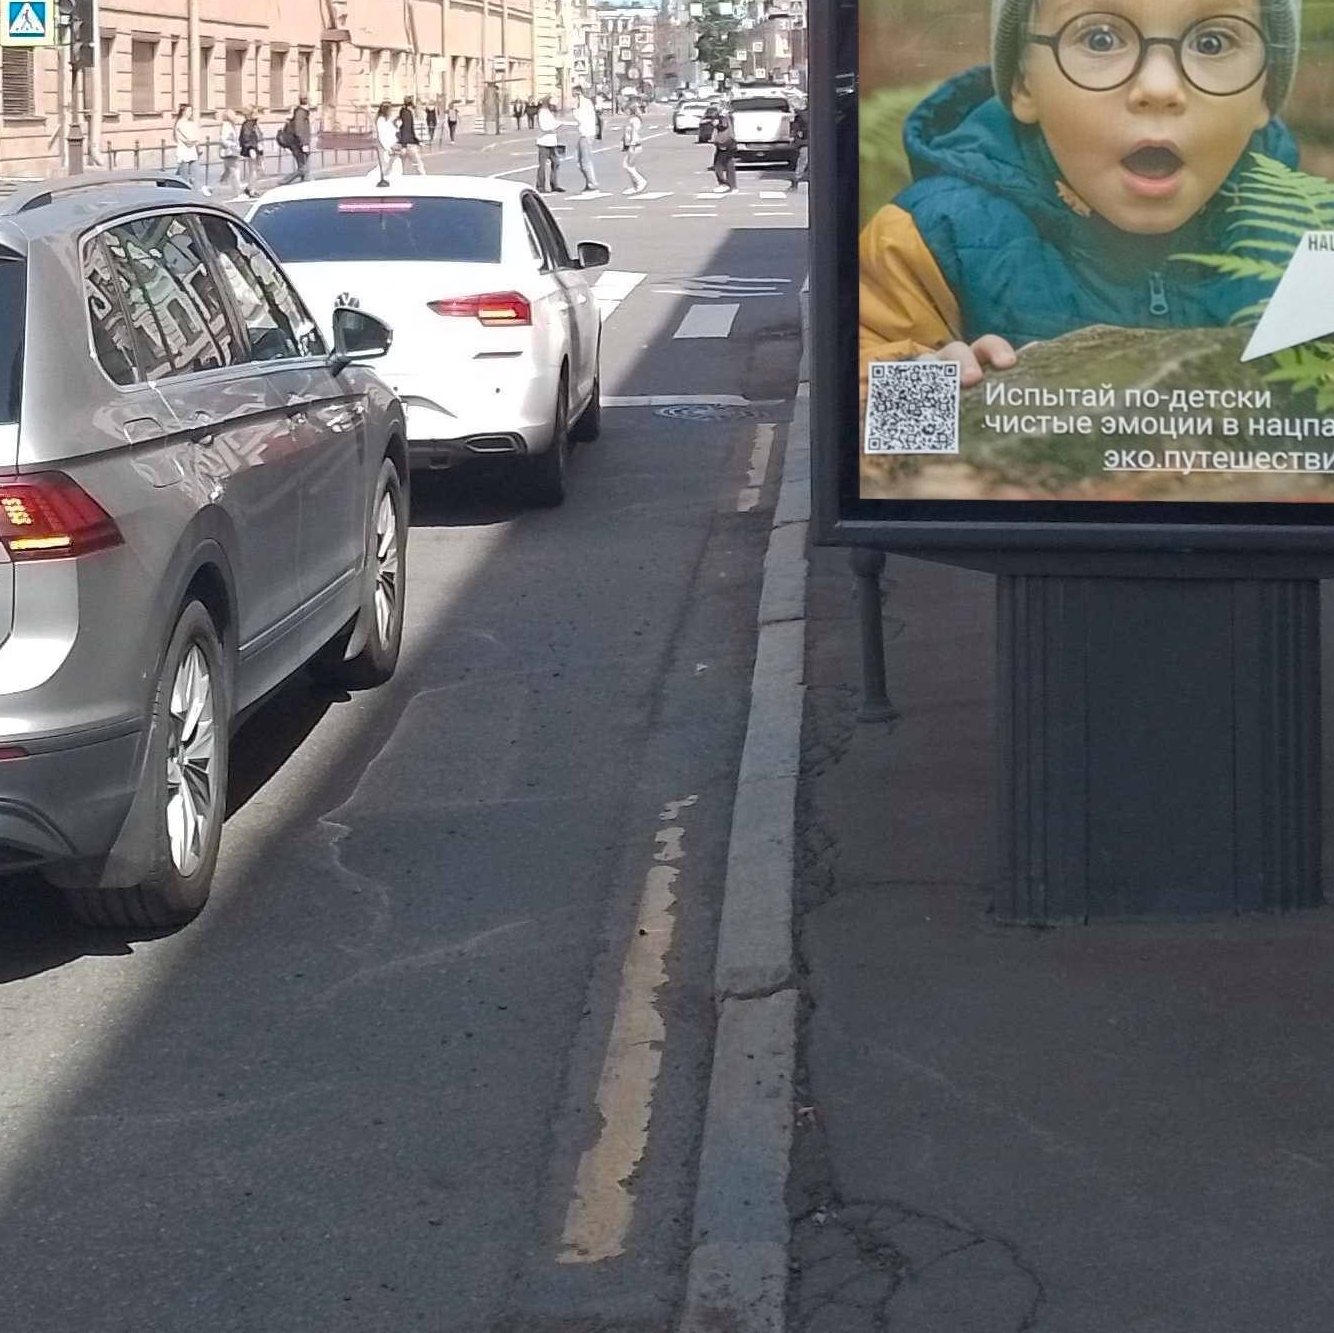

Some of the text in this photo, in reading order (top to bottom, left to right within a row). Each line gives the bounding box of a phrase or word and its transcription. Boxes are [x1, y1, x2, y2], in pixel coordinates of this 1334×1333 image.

[985, 382, 1271, 412] Испытай по-детски
[985, 414, 1092, 434] чистые
[1101, 415, 1213, 439] эмоции
[1222, 417, 1239, 435] в
